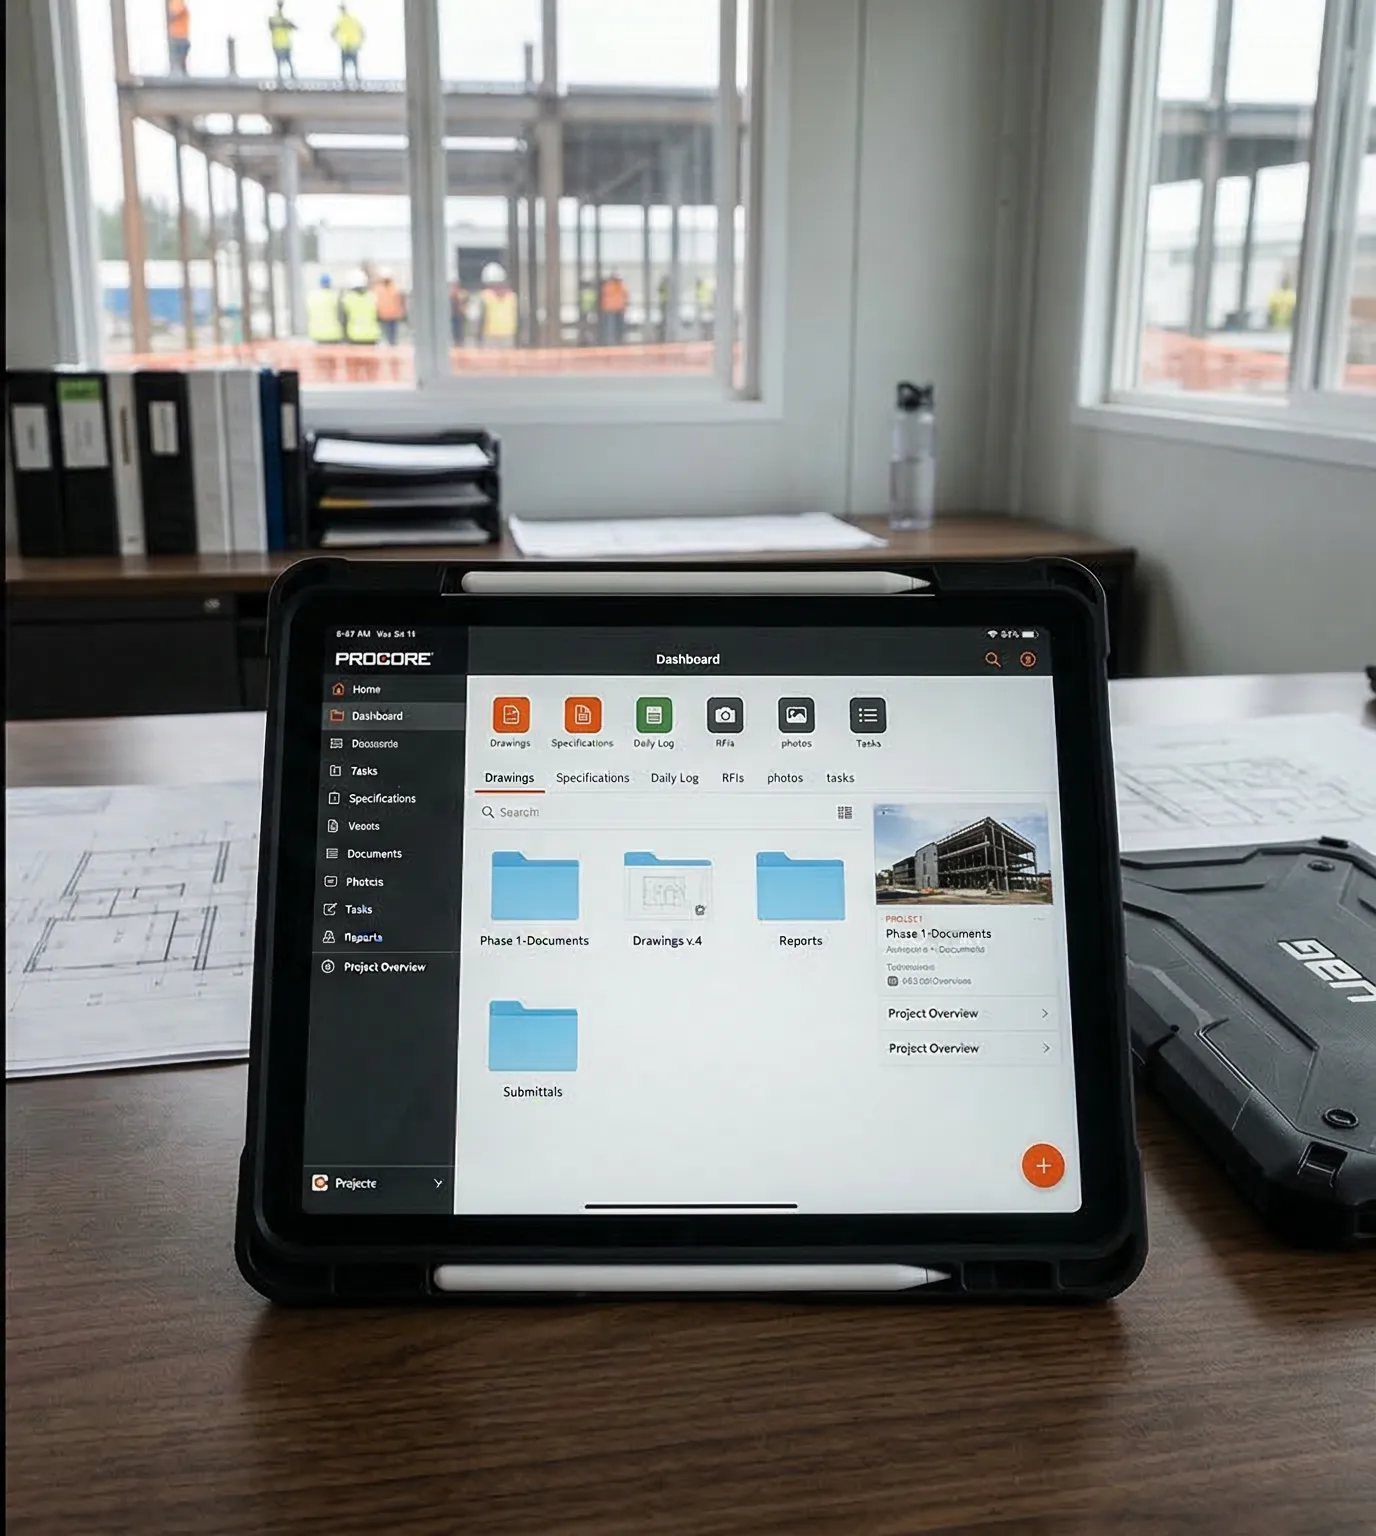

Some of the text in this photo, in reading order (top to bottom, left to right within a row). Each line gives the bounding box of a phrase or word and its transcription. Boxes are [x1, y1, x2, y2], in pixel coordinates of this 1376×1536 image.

[356, 629, 371, 638] AM
[335, 652, 432, 666] PROCORE
[656, 653, 720, 665] Dashboard
[352, 684, 381, 694] Home
[490, 738, 531, 750] Drawings
[551, 738, 614, 750] Specifications
[653, 739, 675, 750] Log
[781, 738, 813, 750] photos
[485, 771, 535, 785] Drawings
[556, 772, 630, 785] Specifications
[651, 772, 699, 786] Daily Log
[722, 772, 745, 783] RFIs
[767, 772, 804, 785] photos
[826, 772, 855, 783] tasks
[349, 793, 417, 806] Specifications
[347, 848, 403, 859] Documents
[344, 904, 373, 915] Tasks
[886, 928, 918, 939] Phase
[480, 935, 590, 946] Phase 1-Documents
[633, 935, 703, 949] Drawings v.4
[779, 935, 823, 949] Reports
[888, 1008, 979, 1021] Project Overview
[929, 1043, 980, 1054] Overview
[503, 1085, 563, 1098] Submittals
